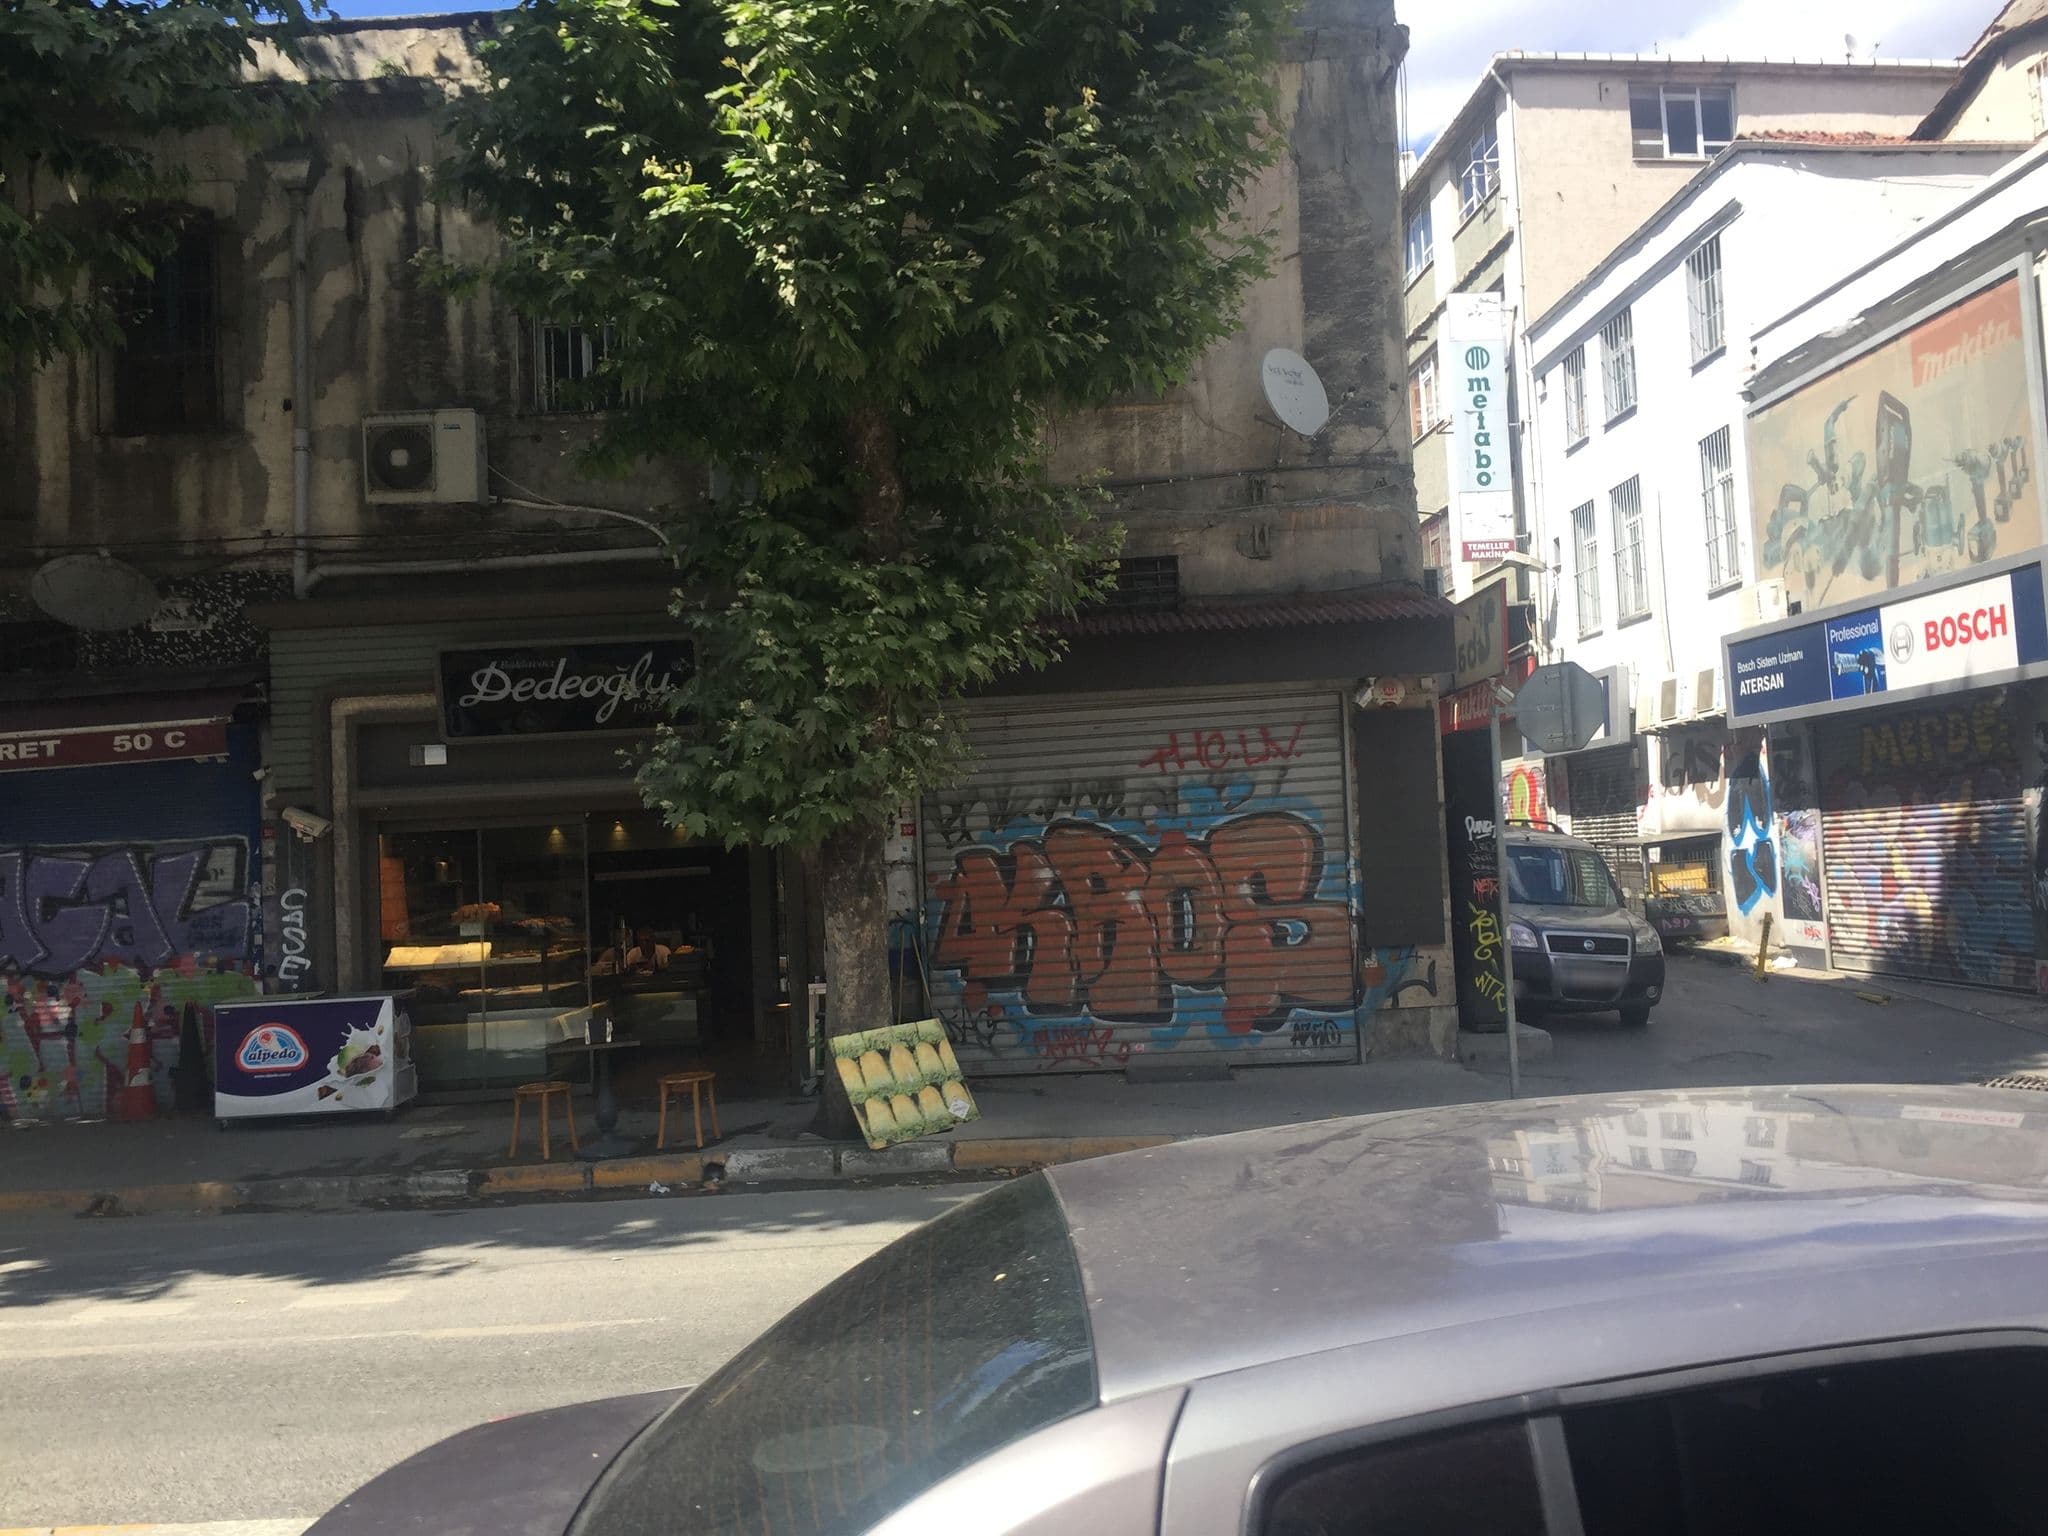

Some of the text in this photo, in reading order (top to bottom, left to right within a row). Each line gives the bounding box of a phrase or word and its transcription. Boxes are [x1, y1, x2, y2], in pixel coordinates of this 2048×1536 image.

[1467, 376, 1492, 487] metabo
[1467, 542, 1510, 551] TEMELLER
[1830, 619, 1879, 644] Professional
[1924, 604, 2008, 652] BOSCH
[1737, 659, 1756, 674] Bosch
[1756, 653, 1778, 669] Sistem
[459, 651, 671, 724] Dedeoğlu
[1740, 672, 1785, 696] ATERSAN
[113, 733, 152, 752] 50
[164, 731, 186, 749] C
[248, 1048, 297, 1063] alpedo
